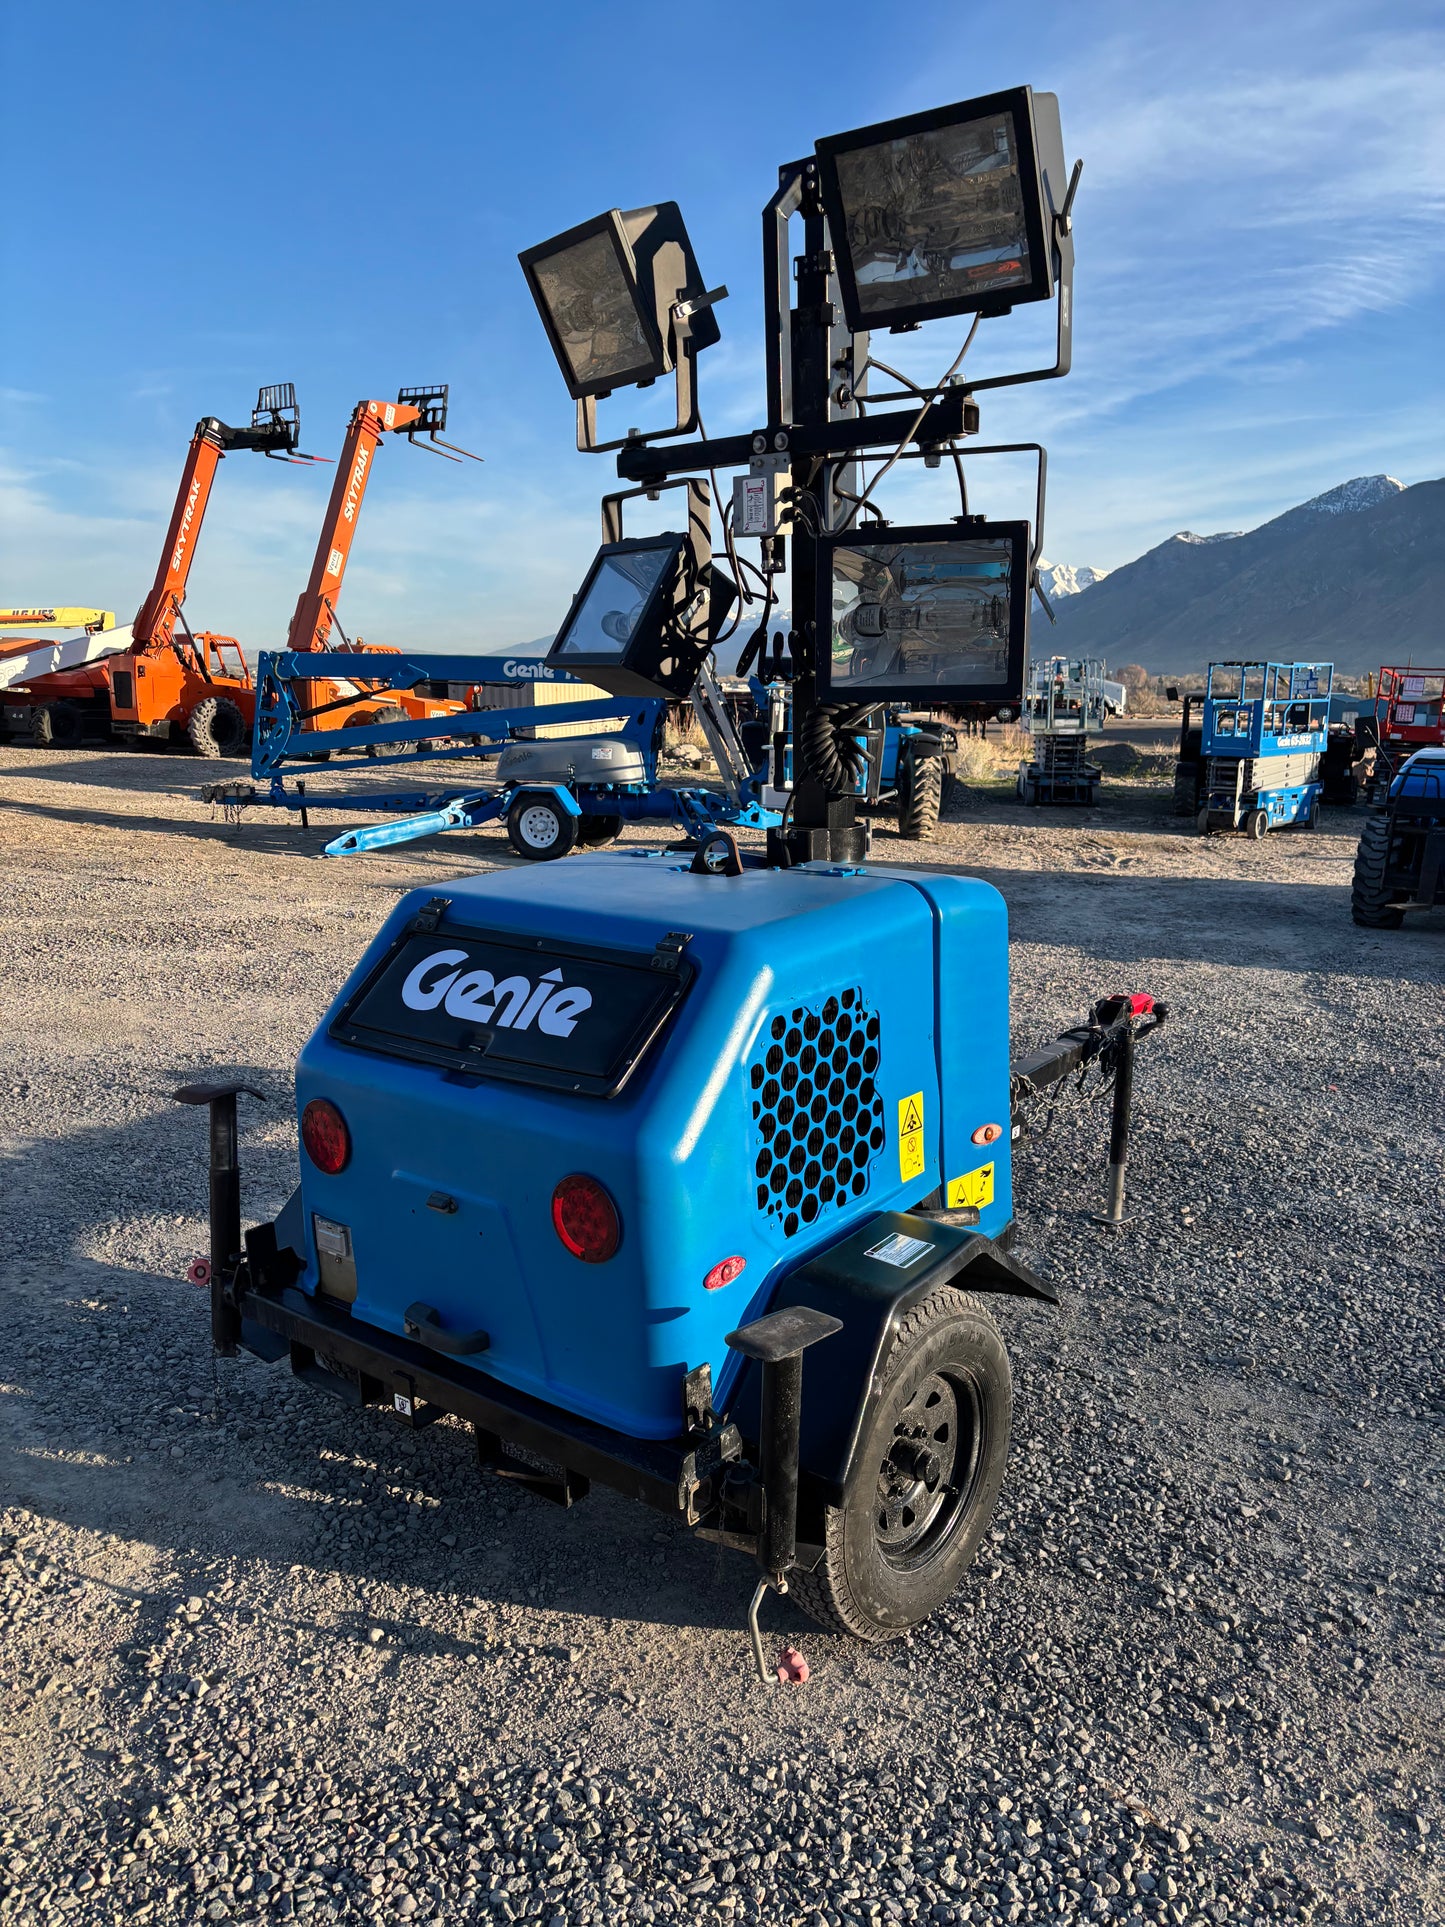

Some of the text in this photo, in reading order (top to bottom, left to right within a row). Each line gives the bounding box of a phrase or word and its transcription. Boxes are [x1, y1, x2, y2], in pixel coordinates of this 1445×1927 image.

[344, 443, 370, 522] SKYTRAK
[172, 478, 201, 572] SKYTRAK
[503, 660, 555, 679] Genie
[401, 949, 593, 1038] Genie
